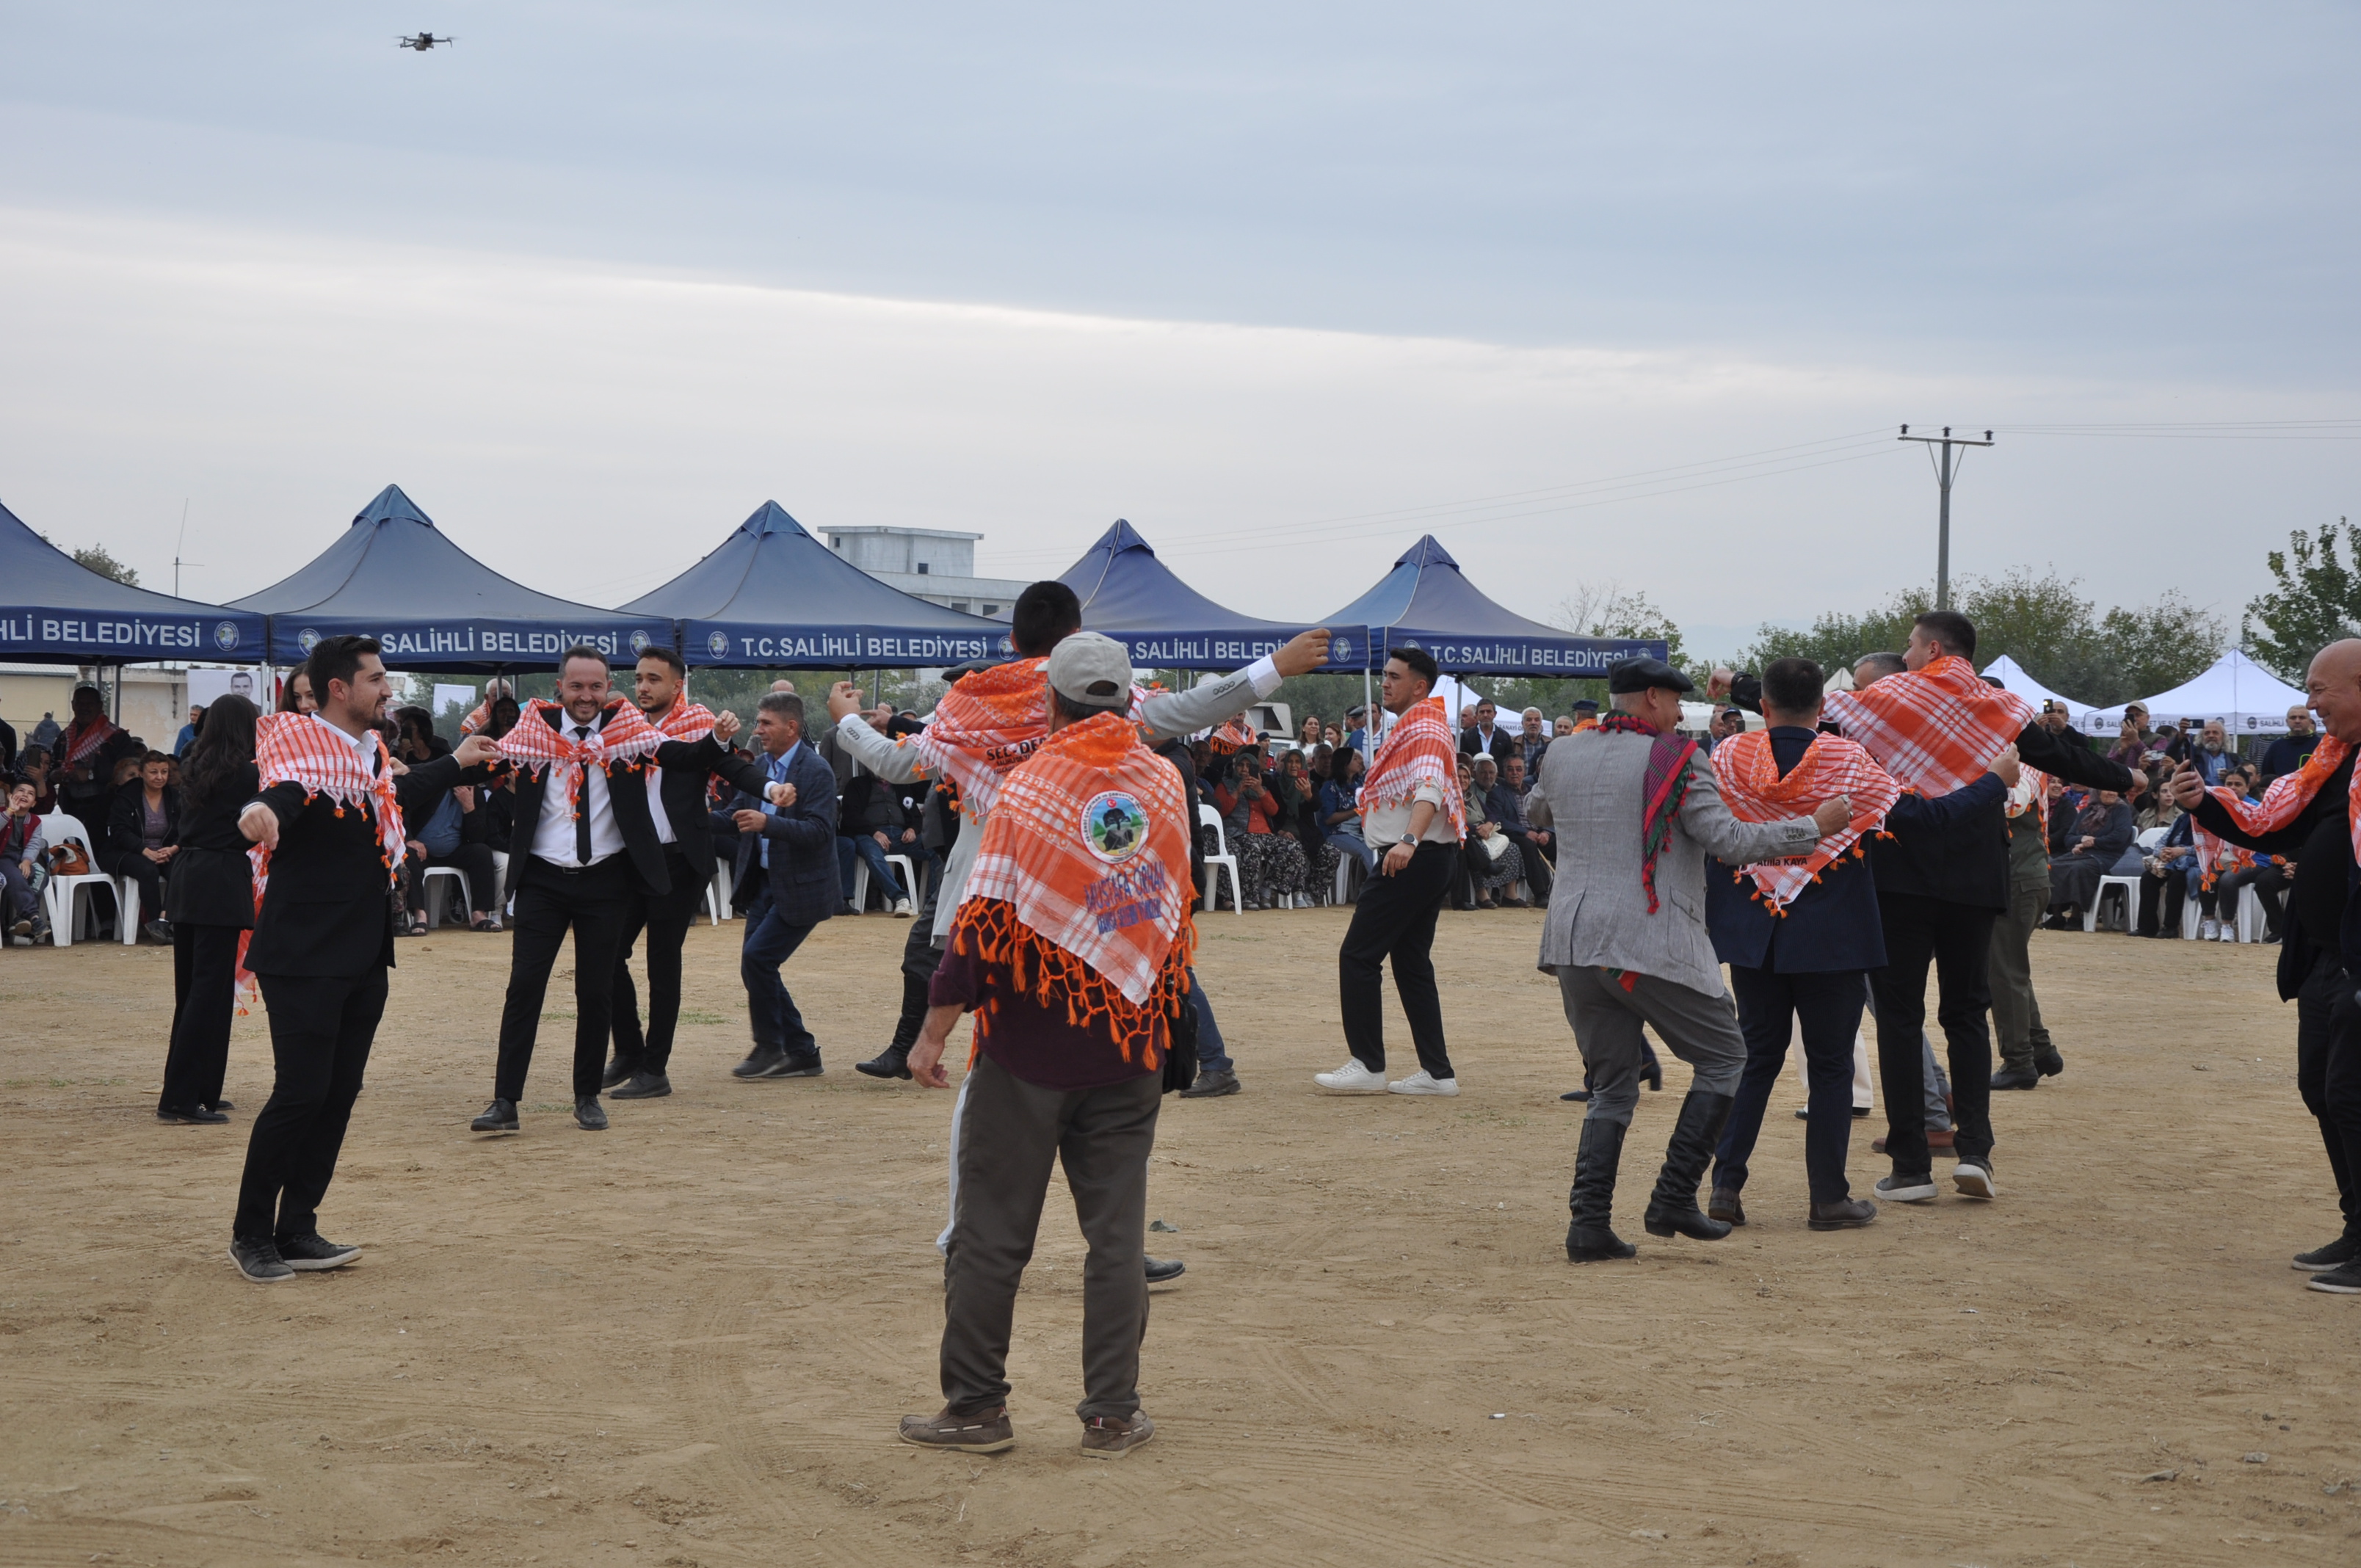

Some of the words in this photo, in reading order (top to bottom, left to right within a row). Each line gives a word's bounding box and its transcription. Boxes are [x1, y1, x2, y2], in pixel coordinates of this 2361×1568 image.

[42, 618, 200, 647] BELEDİYESİ
[336, 627, 474, 654] SALİHLİ
[482, 629, 617, 656] BELEDİYESİ
[741, 633, 861, 657] T.C.SALİHLİ
[867, 635, 987, 658] BELEDİYESİ
[1120, 637, 1209, 660] .SALİHLİ
[1215, 639, 1286, 660] BELEDİ
[1430, 644, 1526, 665] T.C.SALİHLİ
[1784, 857, 1808, 866] KAYA
